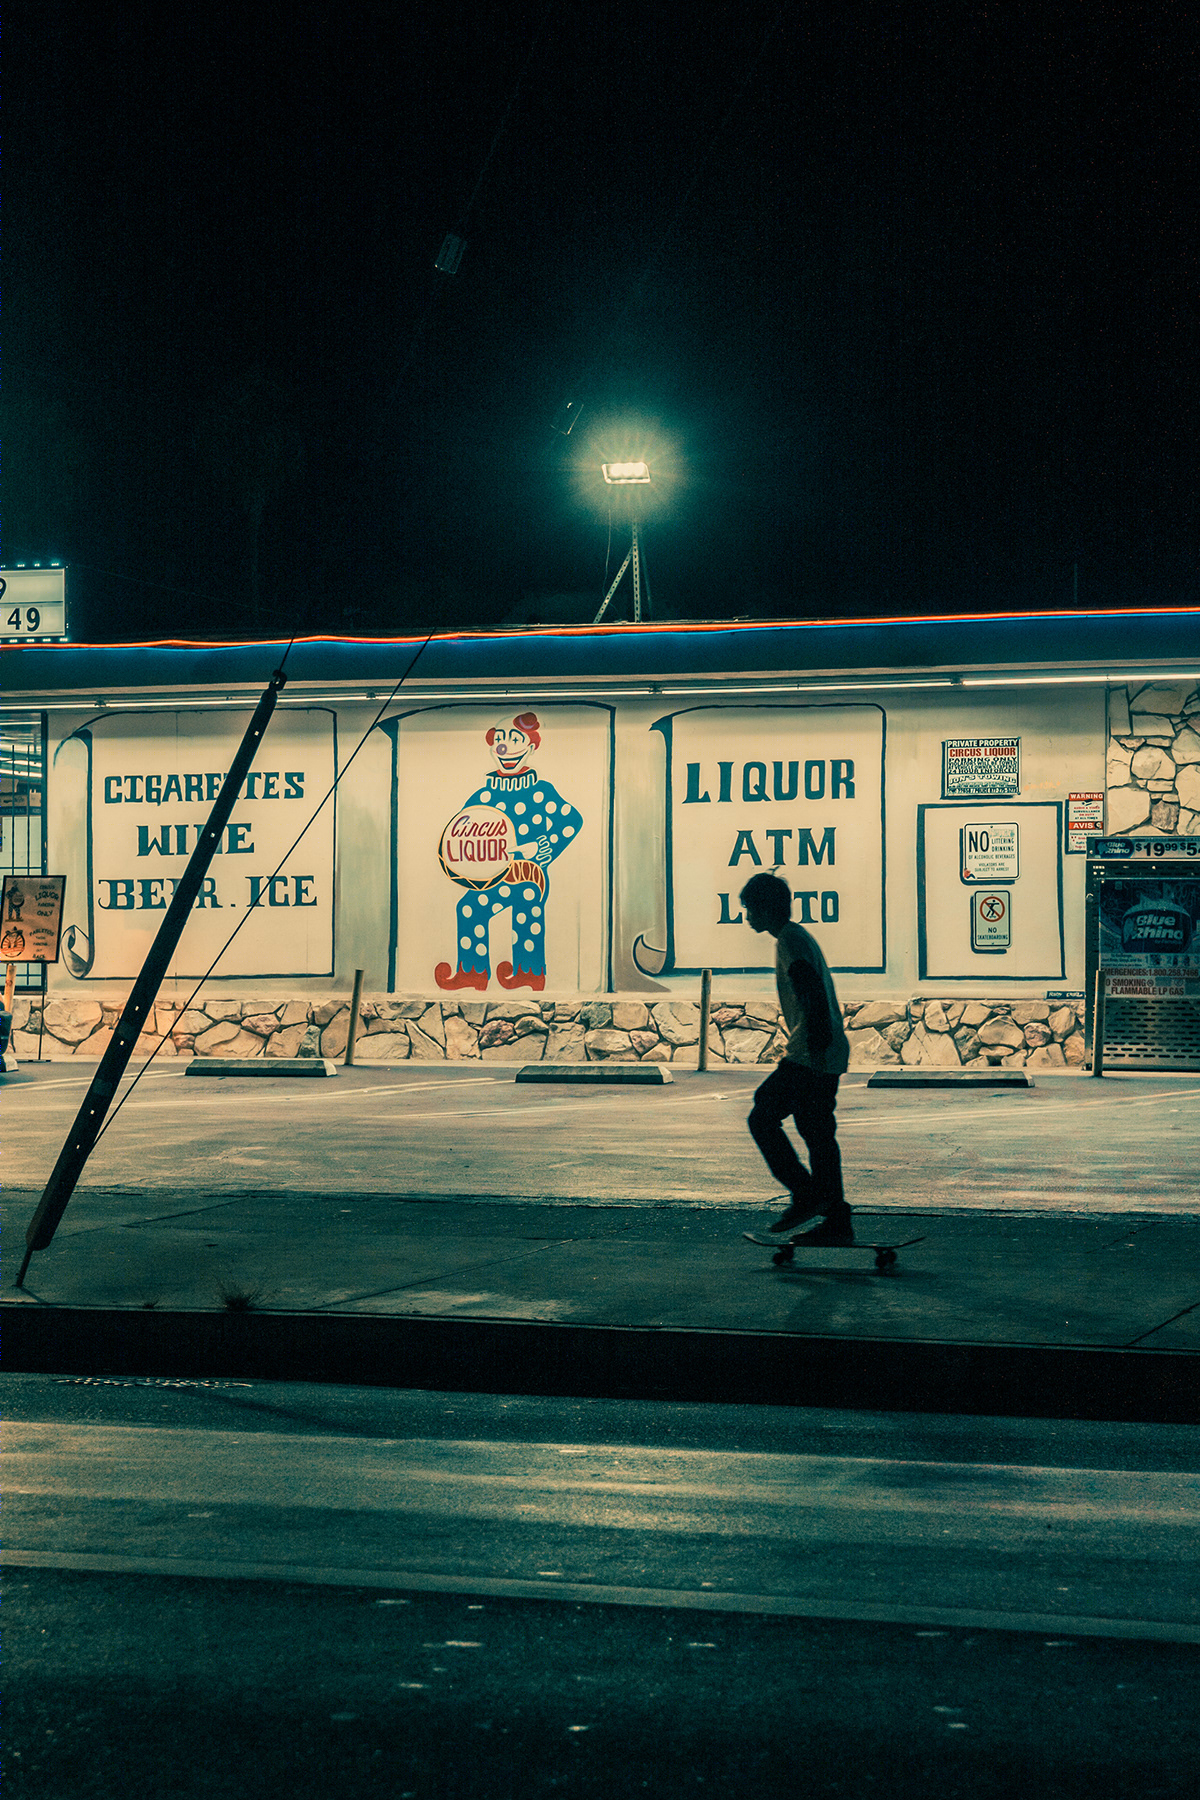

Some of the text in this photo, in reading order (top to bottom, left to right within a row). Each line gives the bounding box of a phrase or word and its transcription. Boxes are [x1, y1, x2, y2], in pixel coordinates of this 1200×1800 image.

[7, 607, 41, 632] 49
[948, 739, 1018, 748] PRIVATE PROPERTY
[949, 747, 1016, 757] CIRCUS LIQUOR
[104, 772, 305, 806] CIGARETES
[682, 759, 855, 804] LIQUOR
[446, 838, 509, 862] LIQUOR
[728, 827, 837, 867] ATM
[969, 831, 989, 852] NO
[1180, 842, 1200, 856] $5
[34, 891, 60, 902] LIQUOR
[245, 875, 318, 908] ICE
[716, 890, 839, 924] LTO
[1136, 914, 1176, 926] Blue
[1111, 987, 1184, 995] FLAMMABLE LP GAS
[1112, 978, 1147, 987] SMOKING
